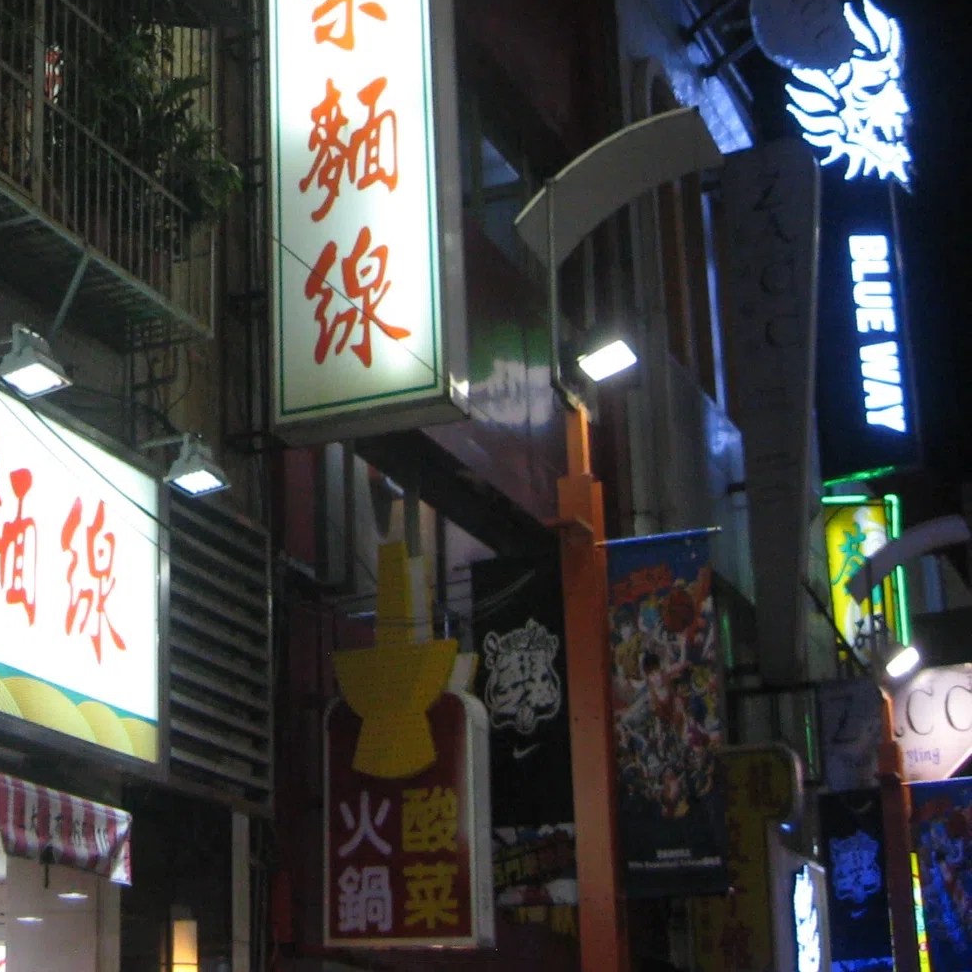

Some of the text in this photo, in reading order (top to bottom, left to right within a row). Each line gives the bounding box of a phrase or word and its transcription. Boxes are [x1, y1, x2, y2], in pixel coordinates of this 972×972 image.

[848, 232, 907, 434] BLUE WAY
[337, 790, 394, 933] 火鍋
[401, 786, 460, 929] 酸菜
